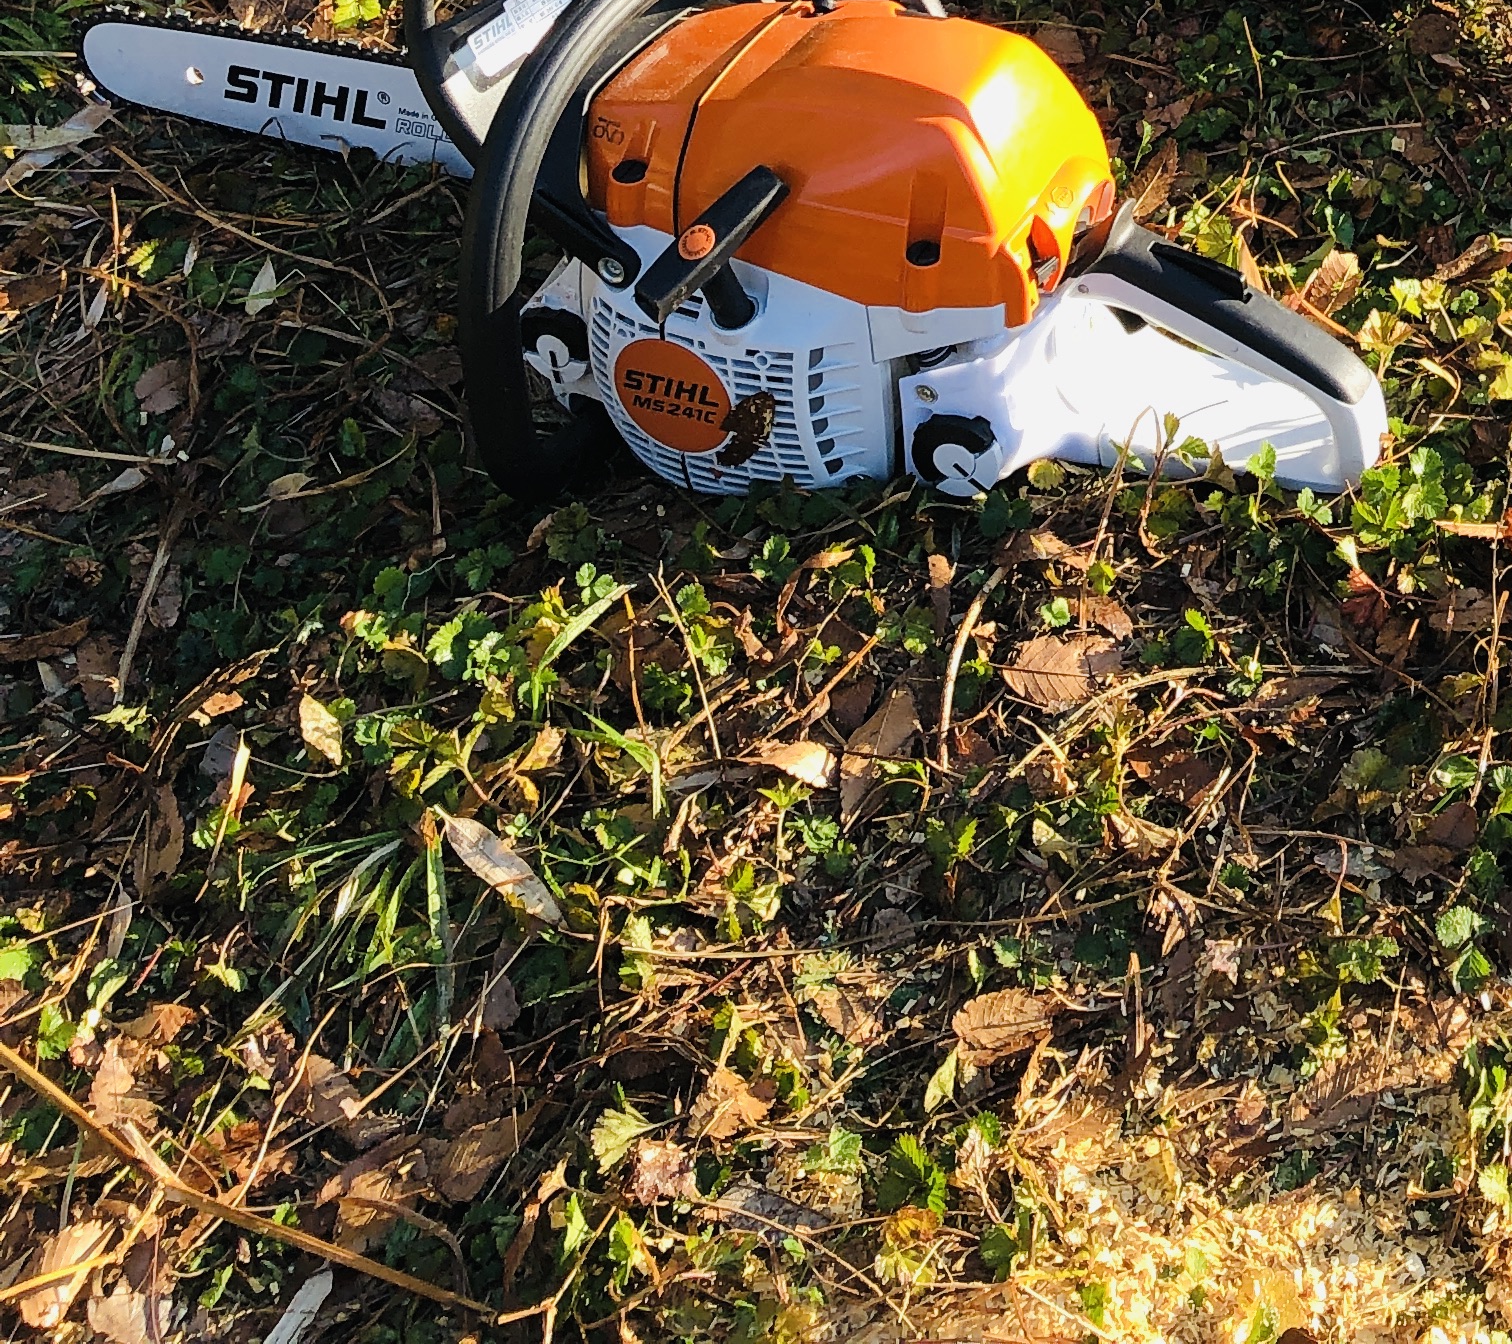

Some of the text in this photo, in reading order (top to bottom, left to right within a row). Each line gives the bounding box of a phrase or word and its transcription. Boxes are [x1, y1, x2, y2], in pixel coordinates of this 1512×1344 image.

[223, 64, 387, 130] STIHL
[398, 107, 420, 119] Made
[623, 369, 720, 408] STIHL
